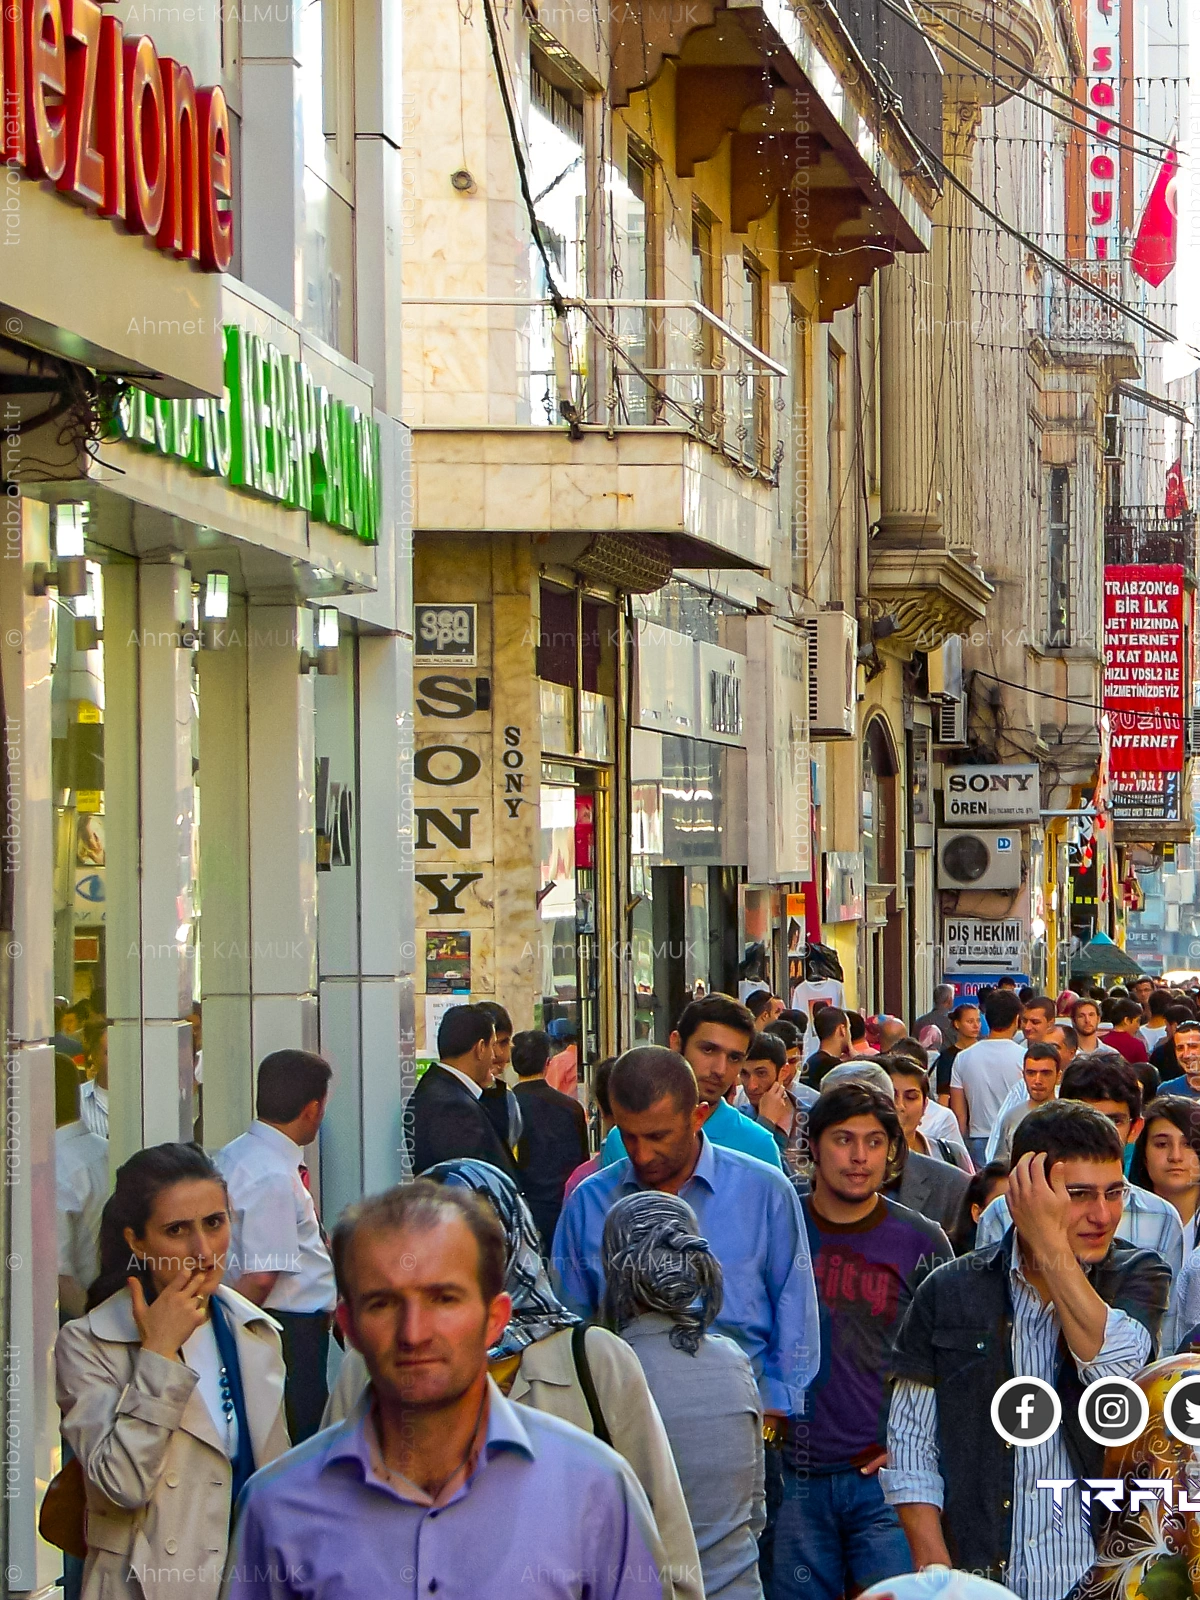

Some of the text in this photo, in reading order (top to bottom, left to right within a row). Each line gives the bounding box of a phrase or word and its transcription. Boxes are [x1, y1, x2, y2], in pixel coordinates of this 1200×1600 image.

[223, 324, 317, 512] KEBAP
[1104, 581, 1179, 595] TRABZON'da
[1115, 596, 1168, 614] BİR İLK
[1105, 618, 1179, 630] JET HIZINDA
[1104, 631, 1179, 646] İNTERNET
[1116, 650, 1141, 663] KAT
[1144, 650, 1178, 663] DAHA
[1104, 667, 1129, 680] HIZLI
[1132, 667, 1163, 681] VDSL2
[1104, 682, 1179, 698] HİZMETİNİZDEYİZ
[1111, 735, 1179, 749] NTERNET
[502, 725, 524, 818] SONY
[948, 773, 1034, 793] SONY
[414, 674, 484, 915] SONY
[951, 798, 988, 815] ÖREN
[948, 922, 1020, 945] DİŞ HEKİMİ
